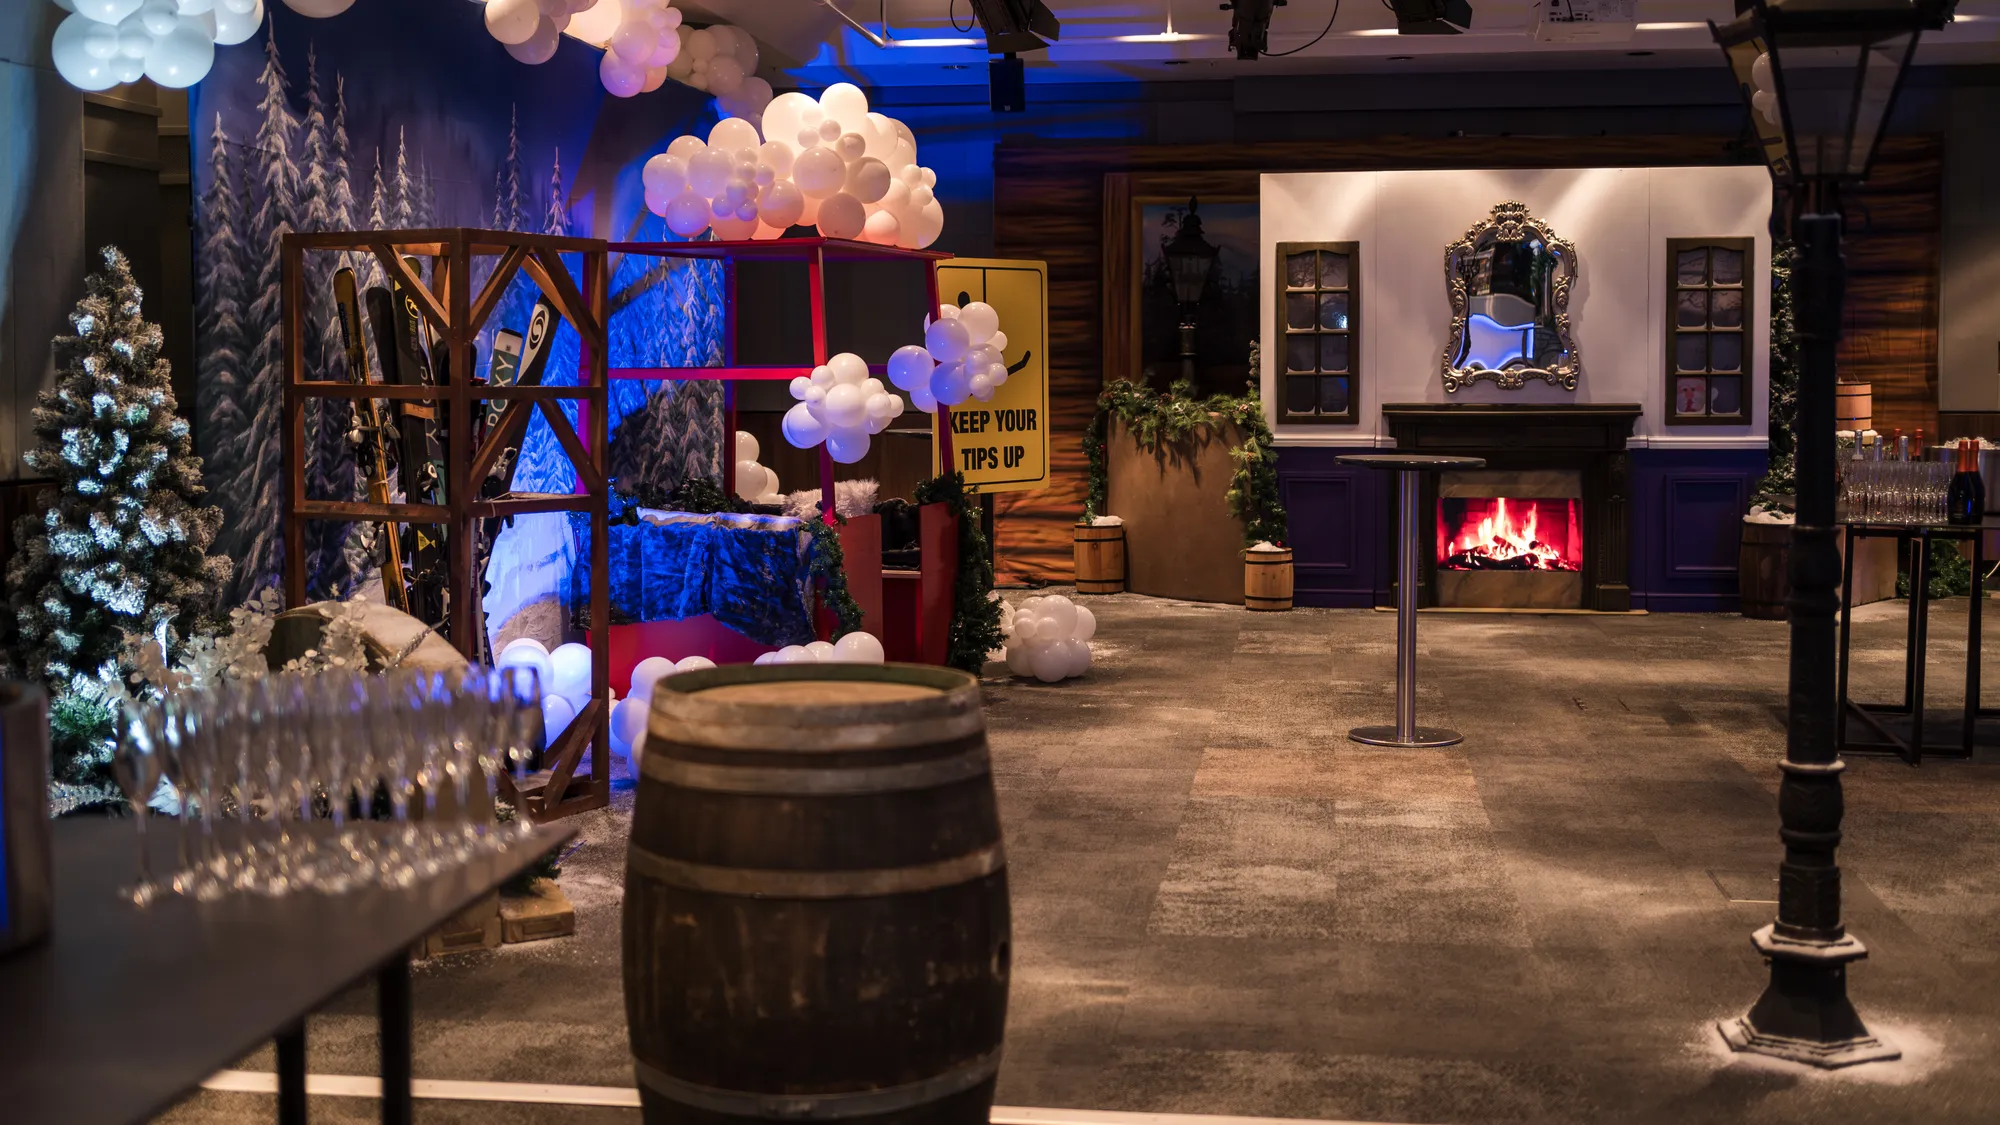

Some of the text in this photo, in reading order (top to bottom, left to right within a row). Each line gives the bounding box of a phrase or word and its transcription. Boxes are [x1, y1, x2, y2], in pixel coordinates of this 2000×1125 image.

[950, 409, 1037, 434] KEEP YOUR
[961, 445, 1025, 470] TIPS UP
